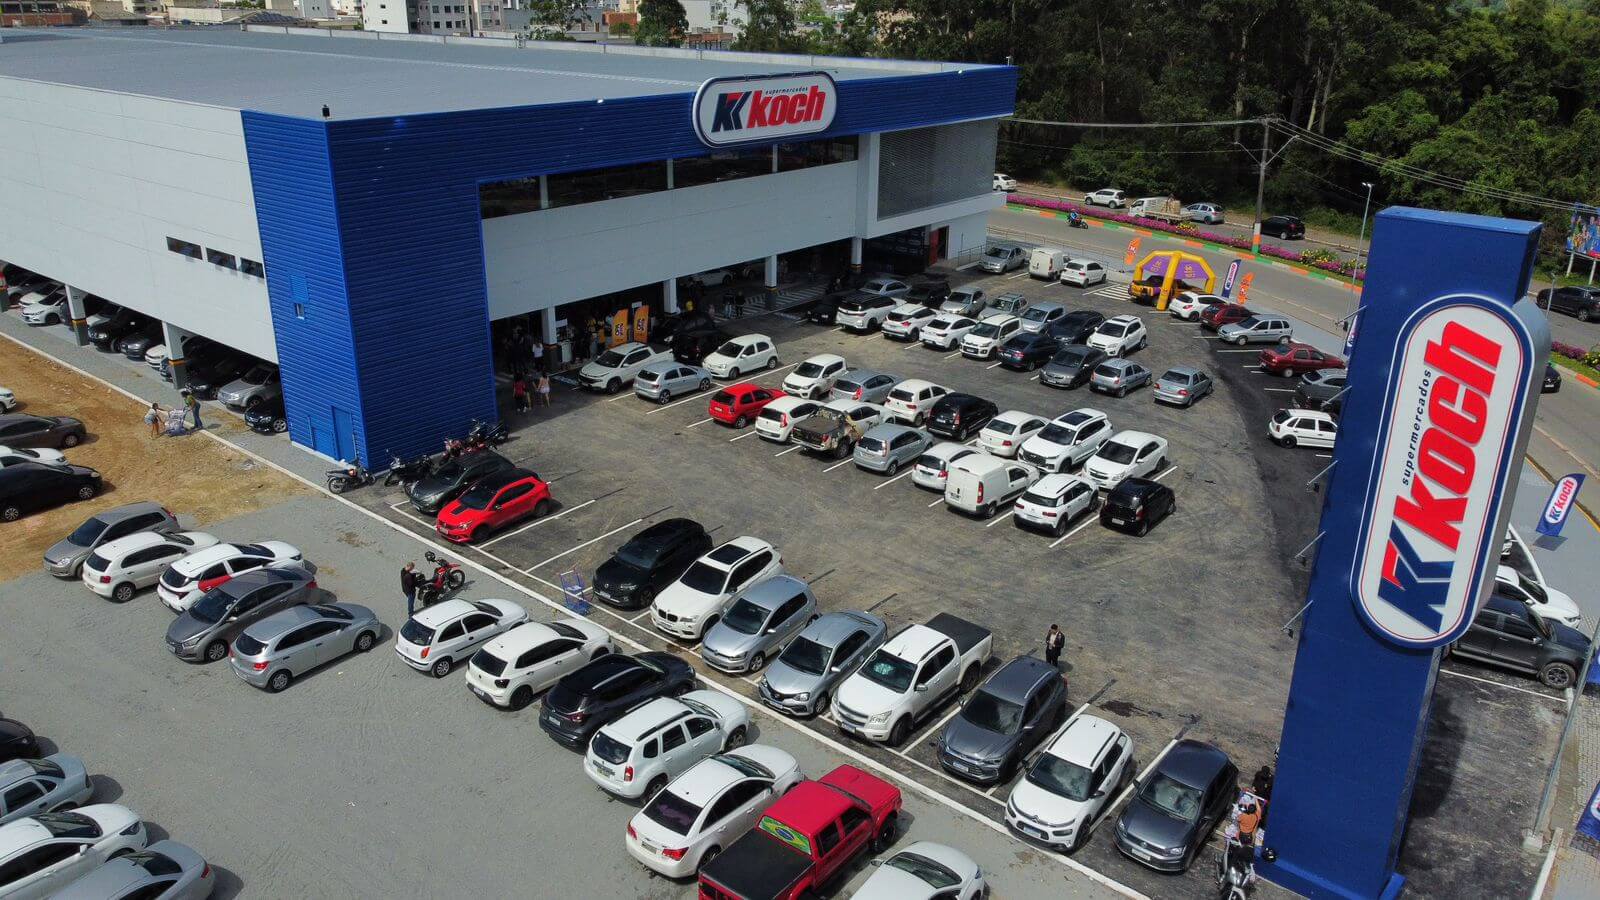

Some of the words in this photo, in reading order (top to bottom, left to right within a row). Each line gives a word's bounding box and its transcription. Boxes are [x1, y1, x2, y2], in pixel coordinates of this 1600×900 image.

[747, 85, 826, 127] koch
[1393, 320, 1502, 552] koch
[1401, 370, 1432, 486] supermercados
